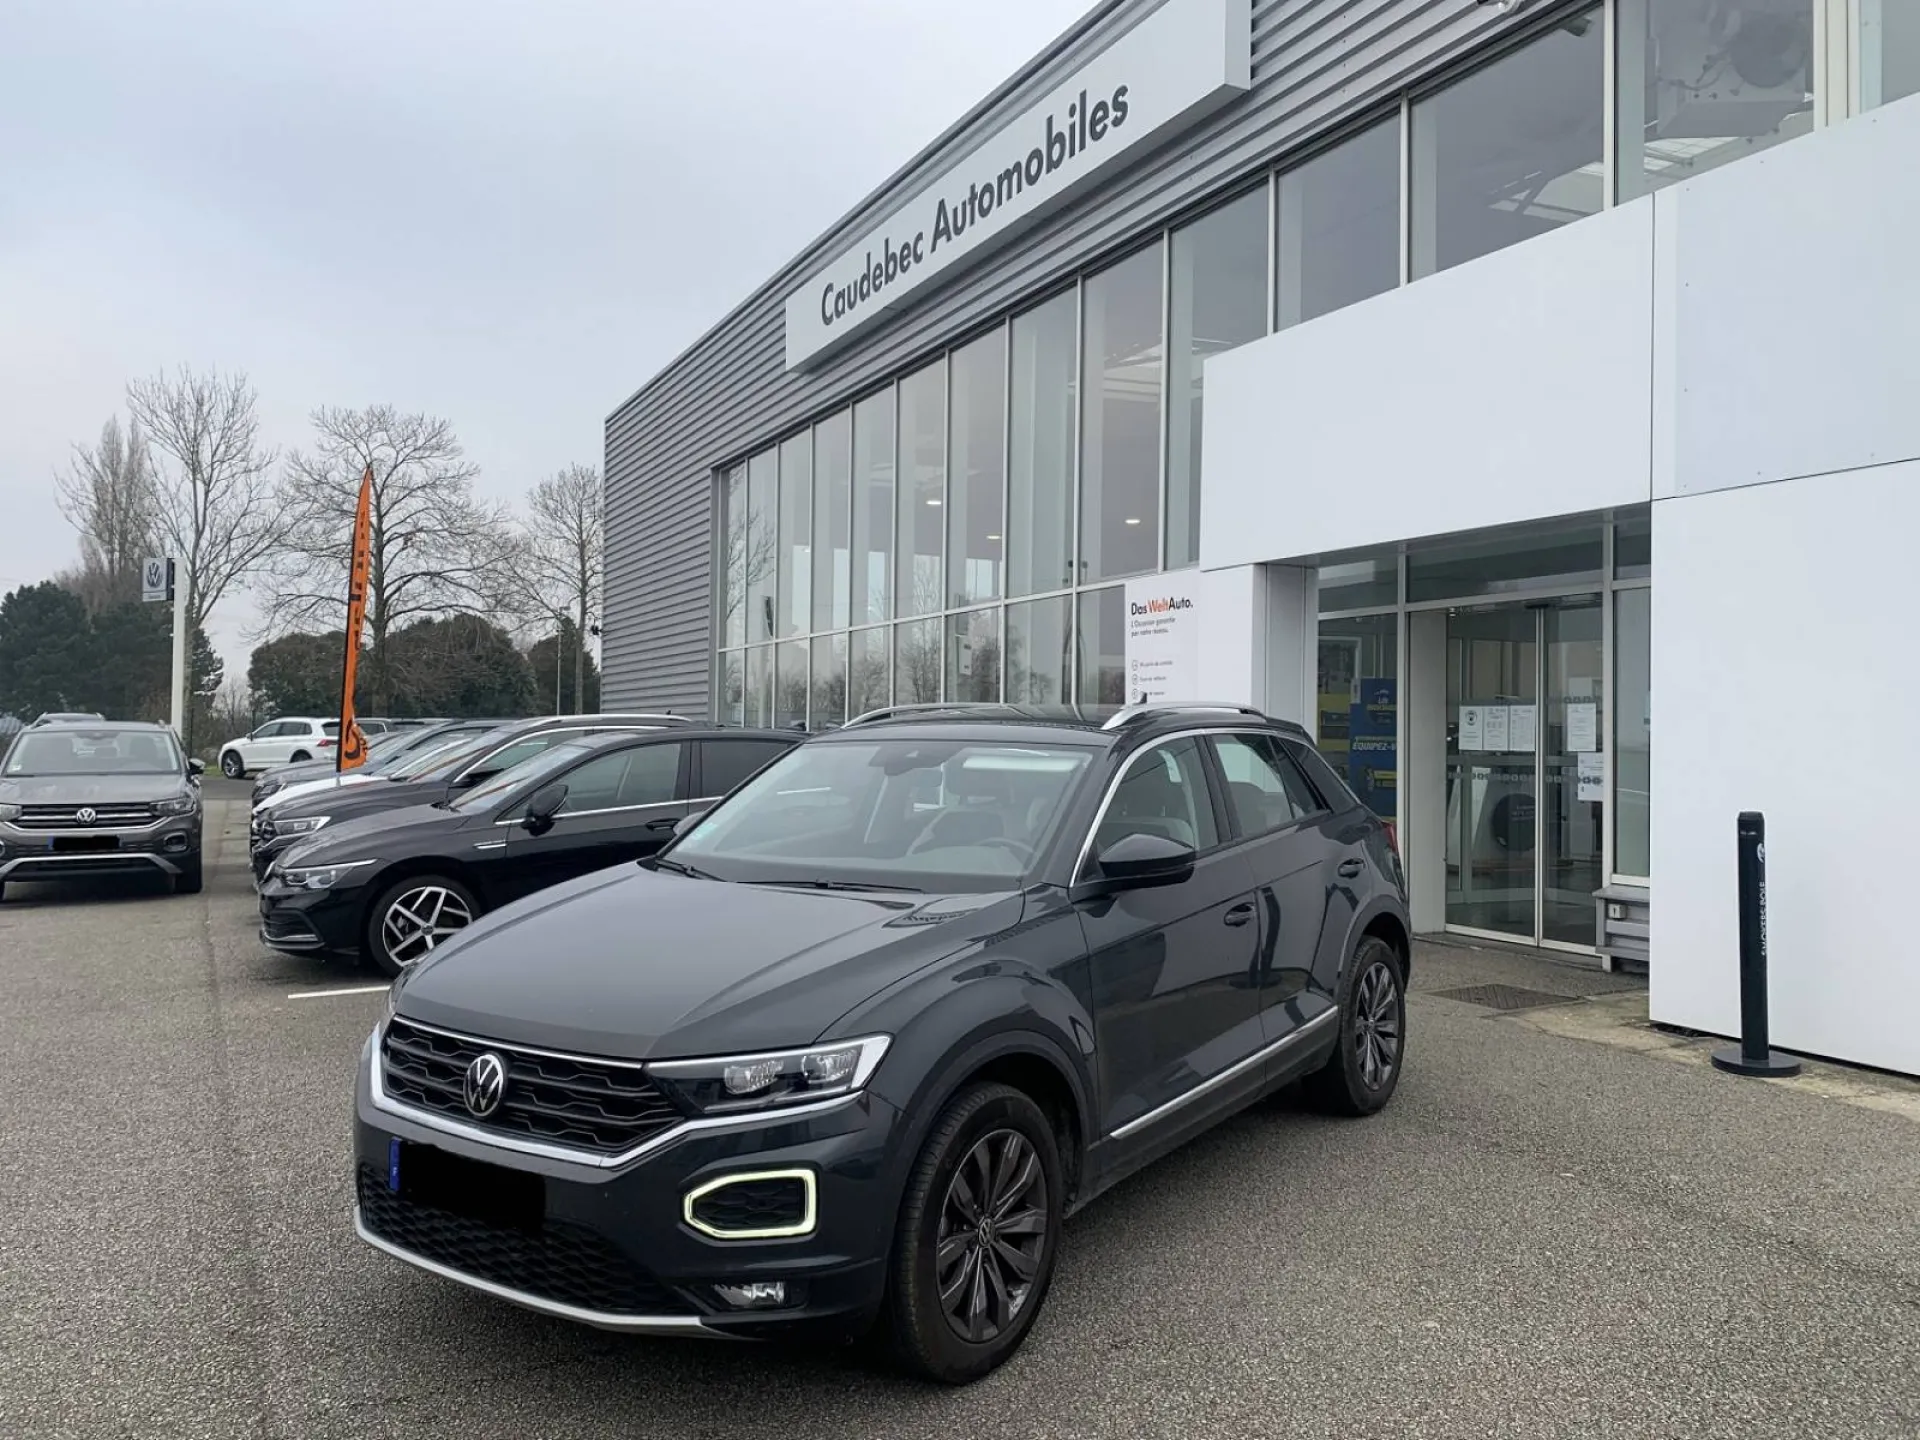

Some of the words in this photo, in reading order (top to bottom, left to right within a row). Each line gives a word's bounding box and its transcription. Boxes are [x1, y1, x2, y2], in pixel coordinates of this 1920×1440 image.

[821, 230, 924, 326] Caudebec
[930, 84, 1129, 253] Automobiles
[1131, 602, 1147, 615] Das
